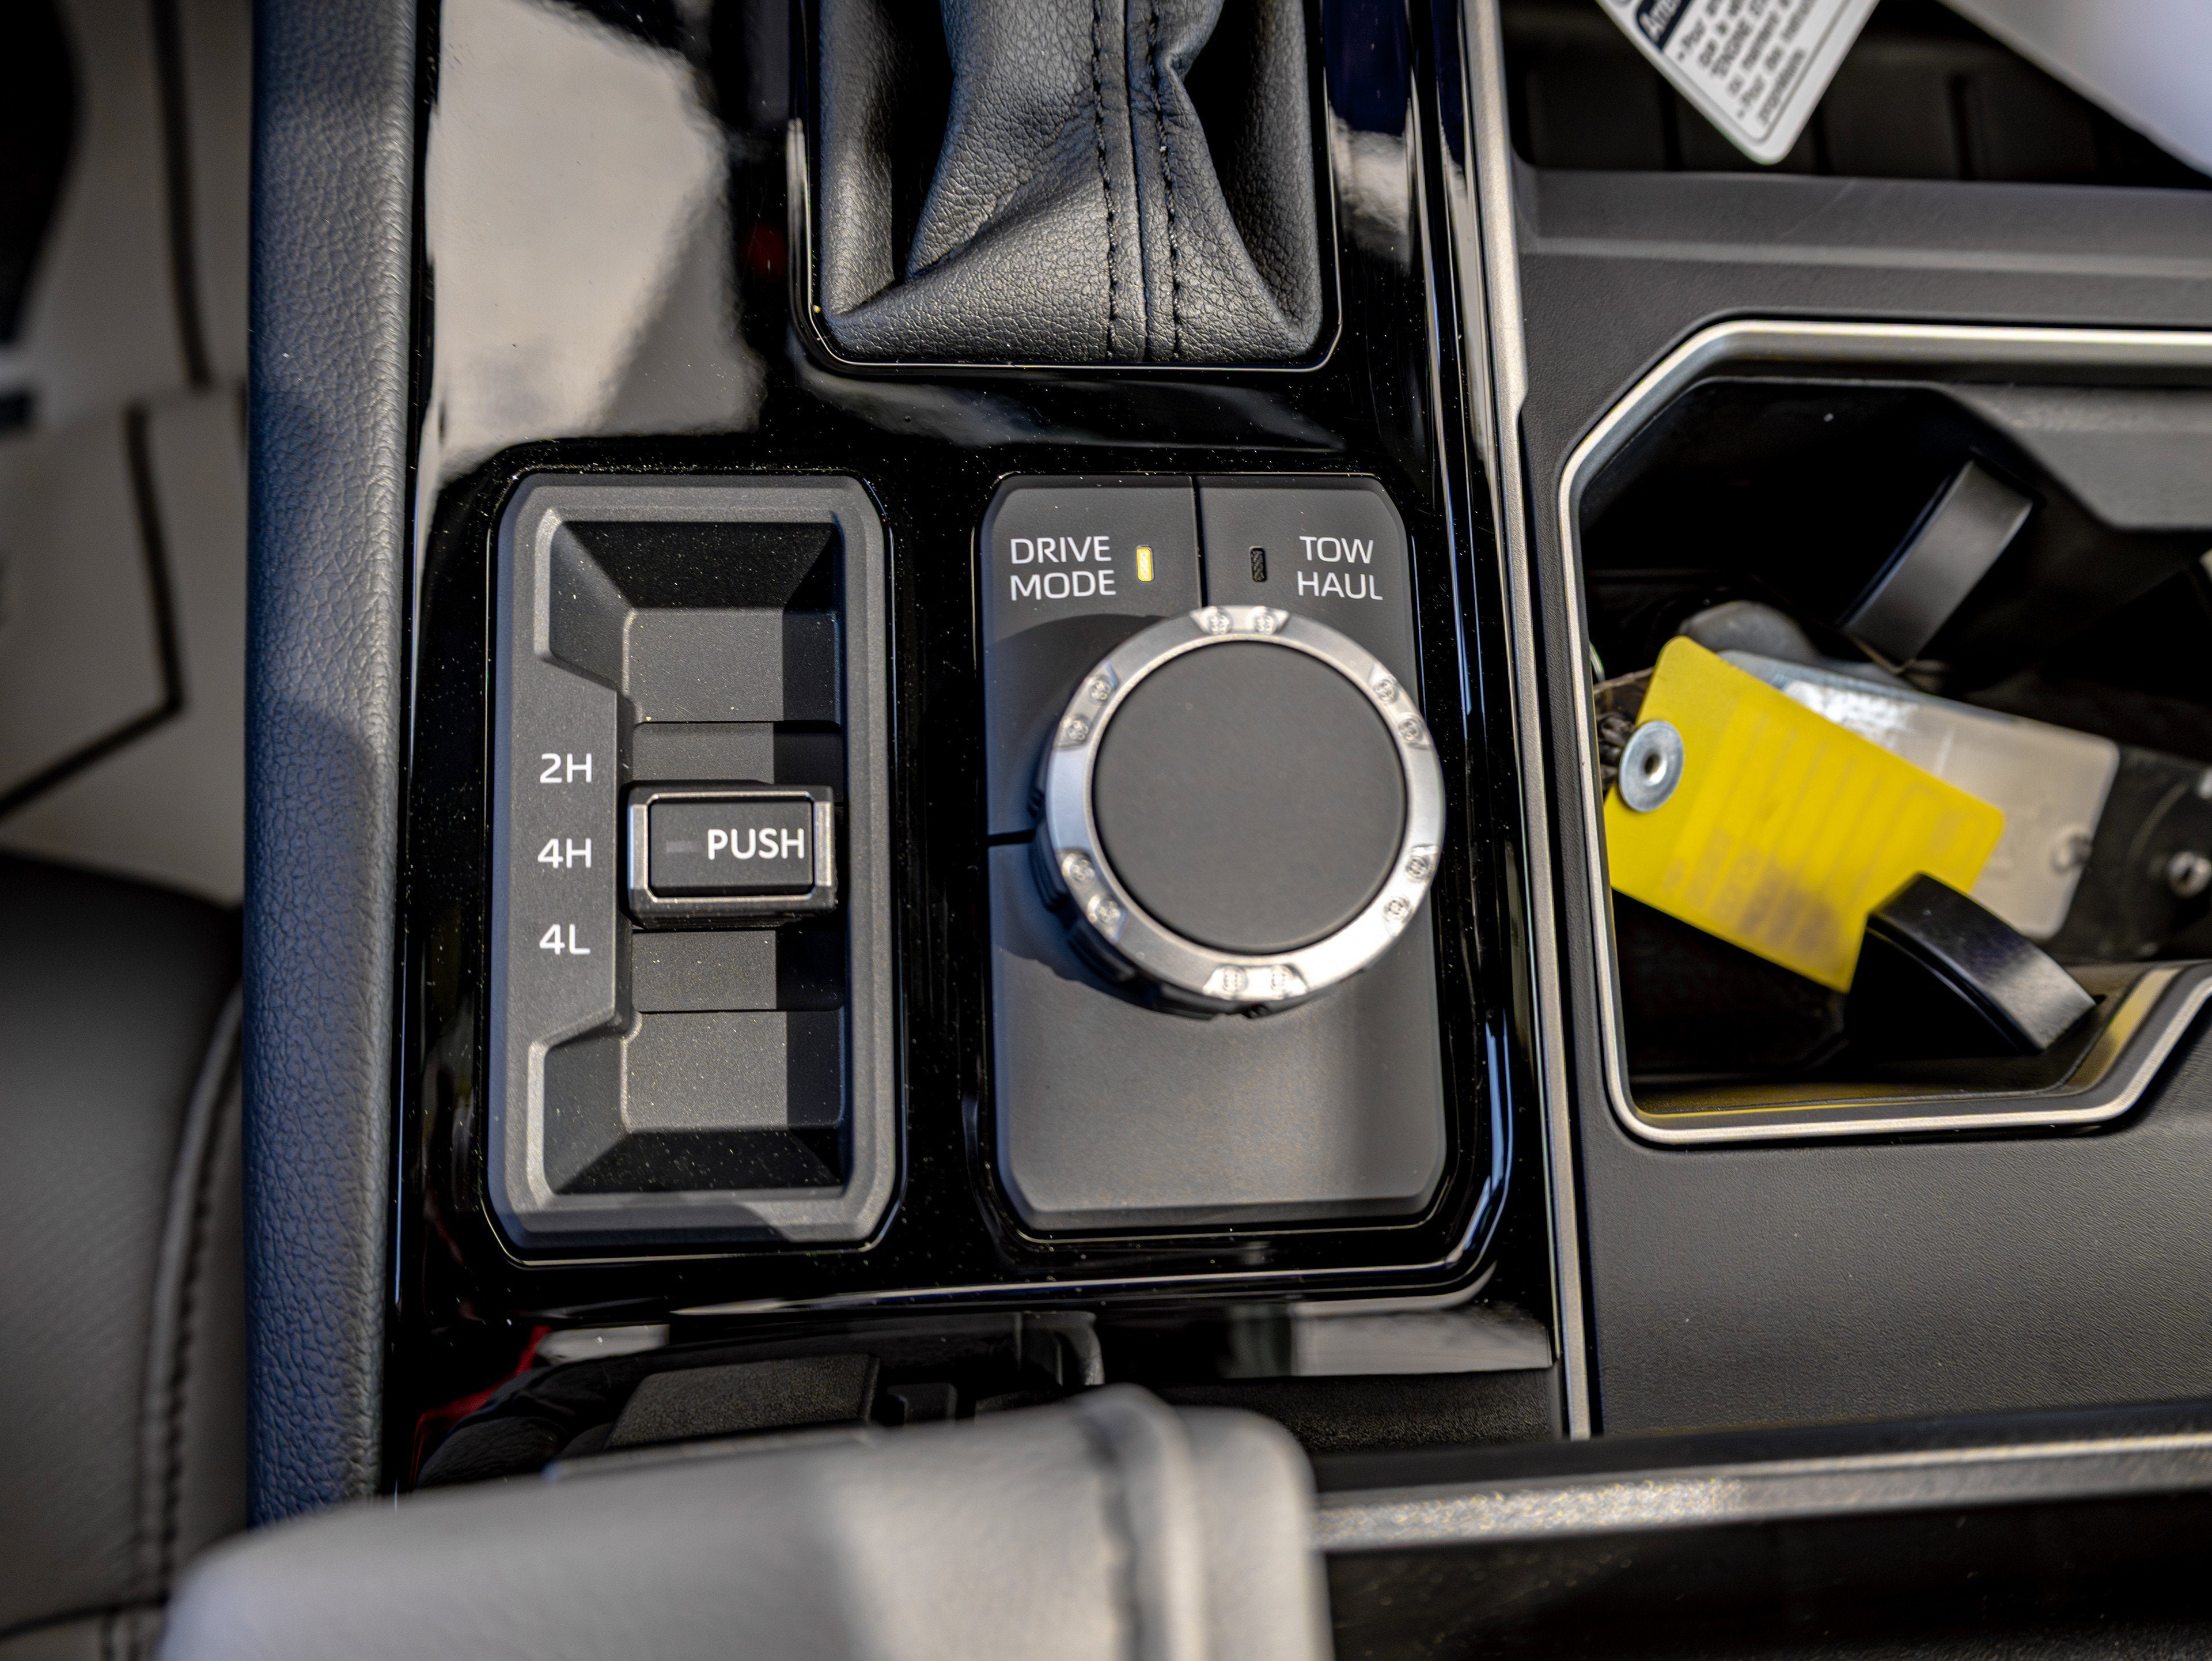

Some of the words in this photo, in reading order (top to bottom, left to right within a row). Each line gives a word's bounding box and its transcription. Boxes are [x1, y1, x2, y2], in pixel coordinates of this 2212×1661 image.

[1010, 536, 1112, 564] DRIVE
[1298, 536, 1374, 564] TOW
[1010, 569, 1116, 601] MODE
[1297, 570, 1383, 600] HAUL
[539, 752, 592, 784] 2H
[537, 837, 592, 869] 4H
[707, 827, 805, 861] PUSH
[539, 923, 591, 956] 4L
